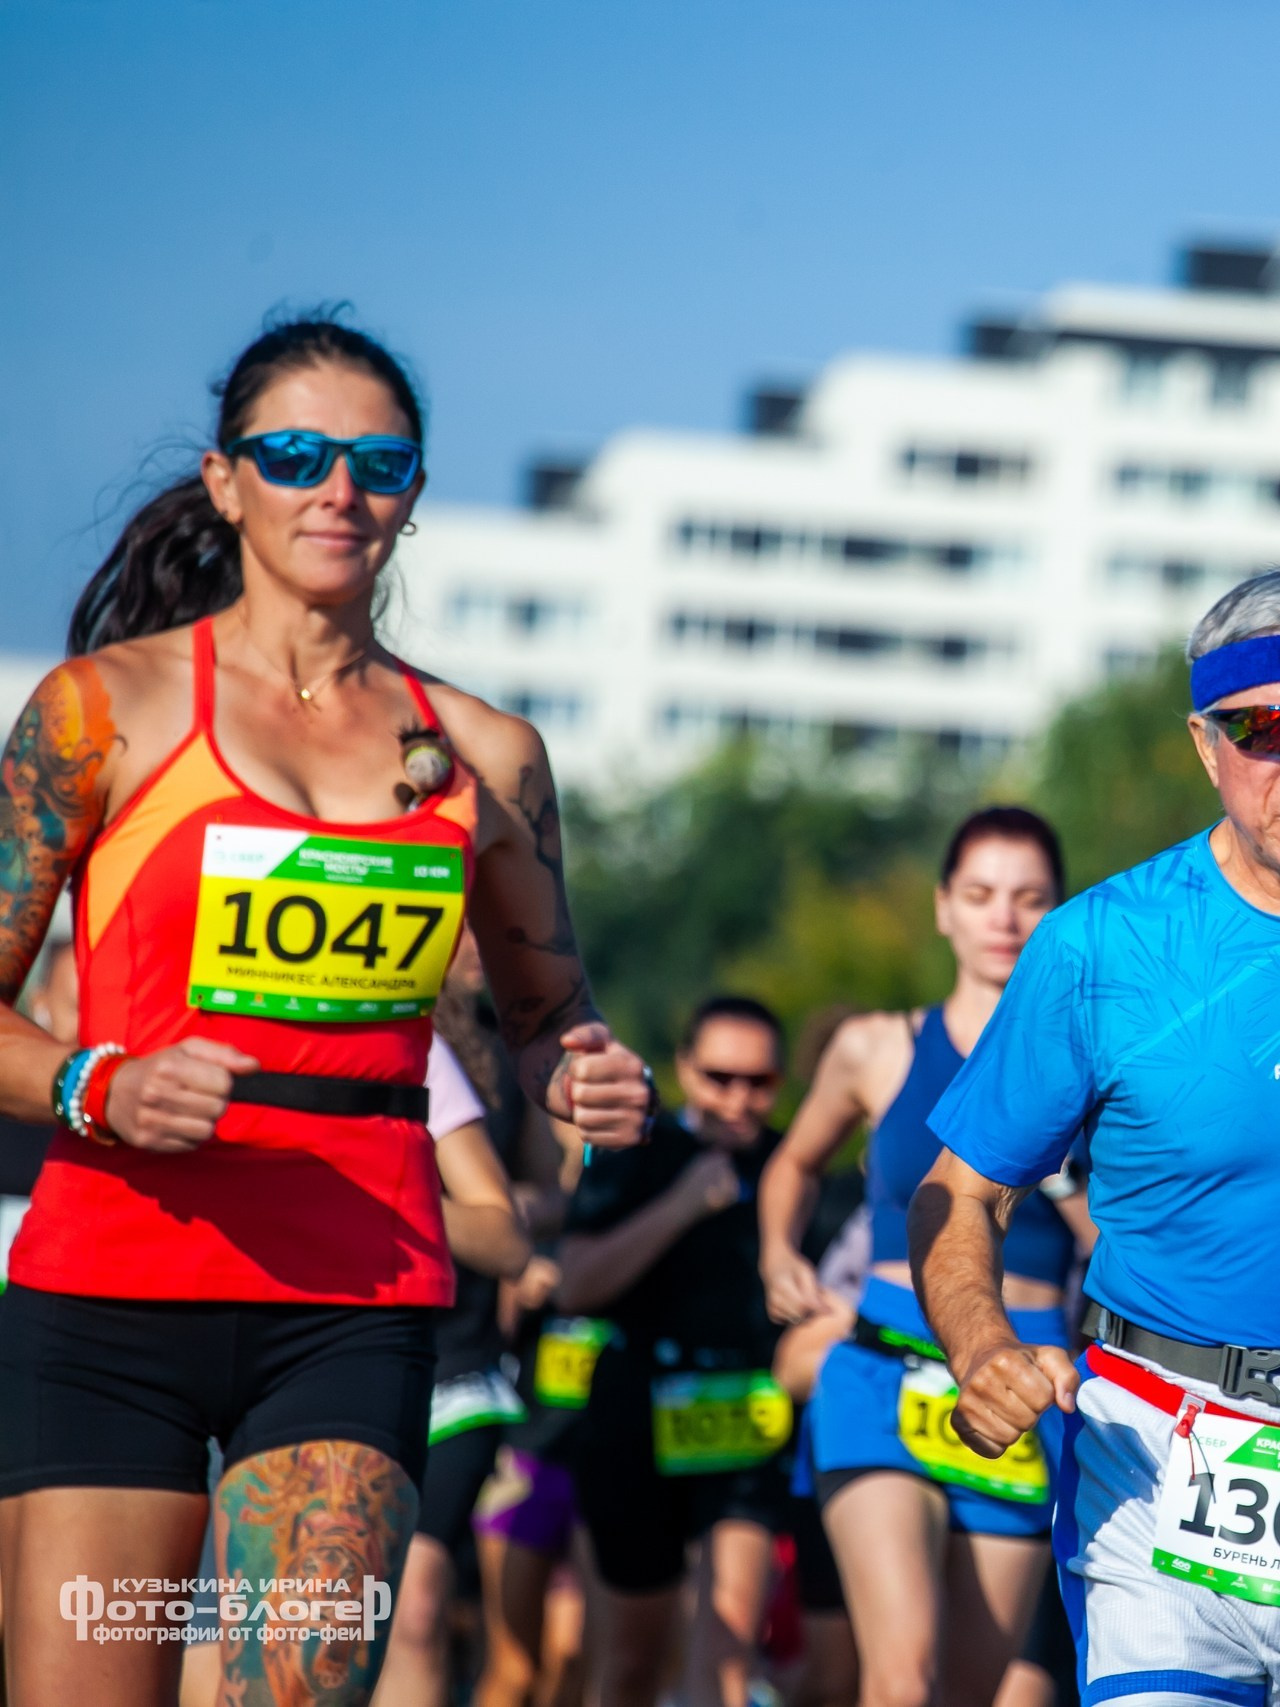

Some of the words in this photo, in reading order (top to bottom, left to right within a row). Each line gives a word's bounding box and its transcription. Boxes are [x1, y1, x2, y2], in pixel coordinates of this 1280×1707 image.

[217, 891, 445, 972] 1047
[1199, 1435, 1228, 1448] СБЕР
[1213, 1547, 1268, 1567] БУРЕНЬ
